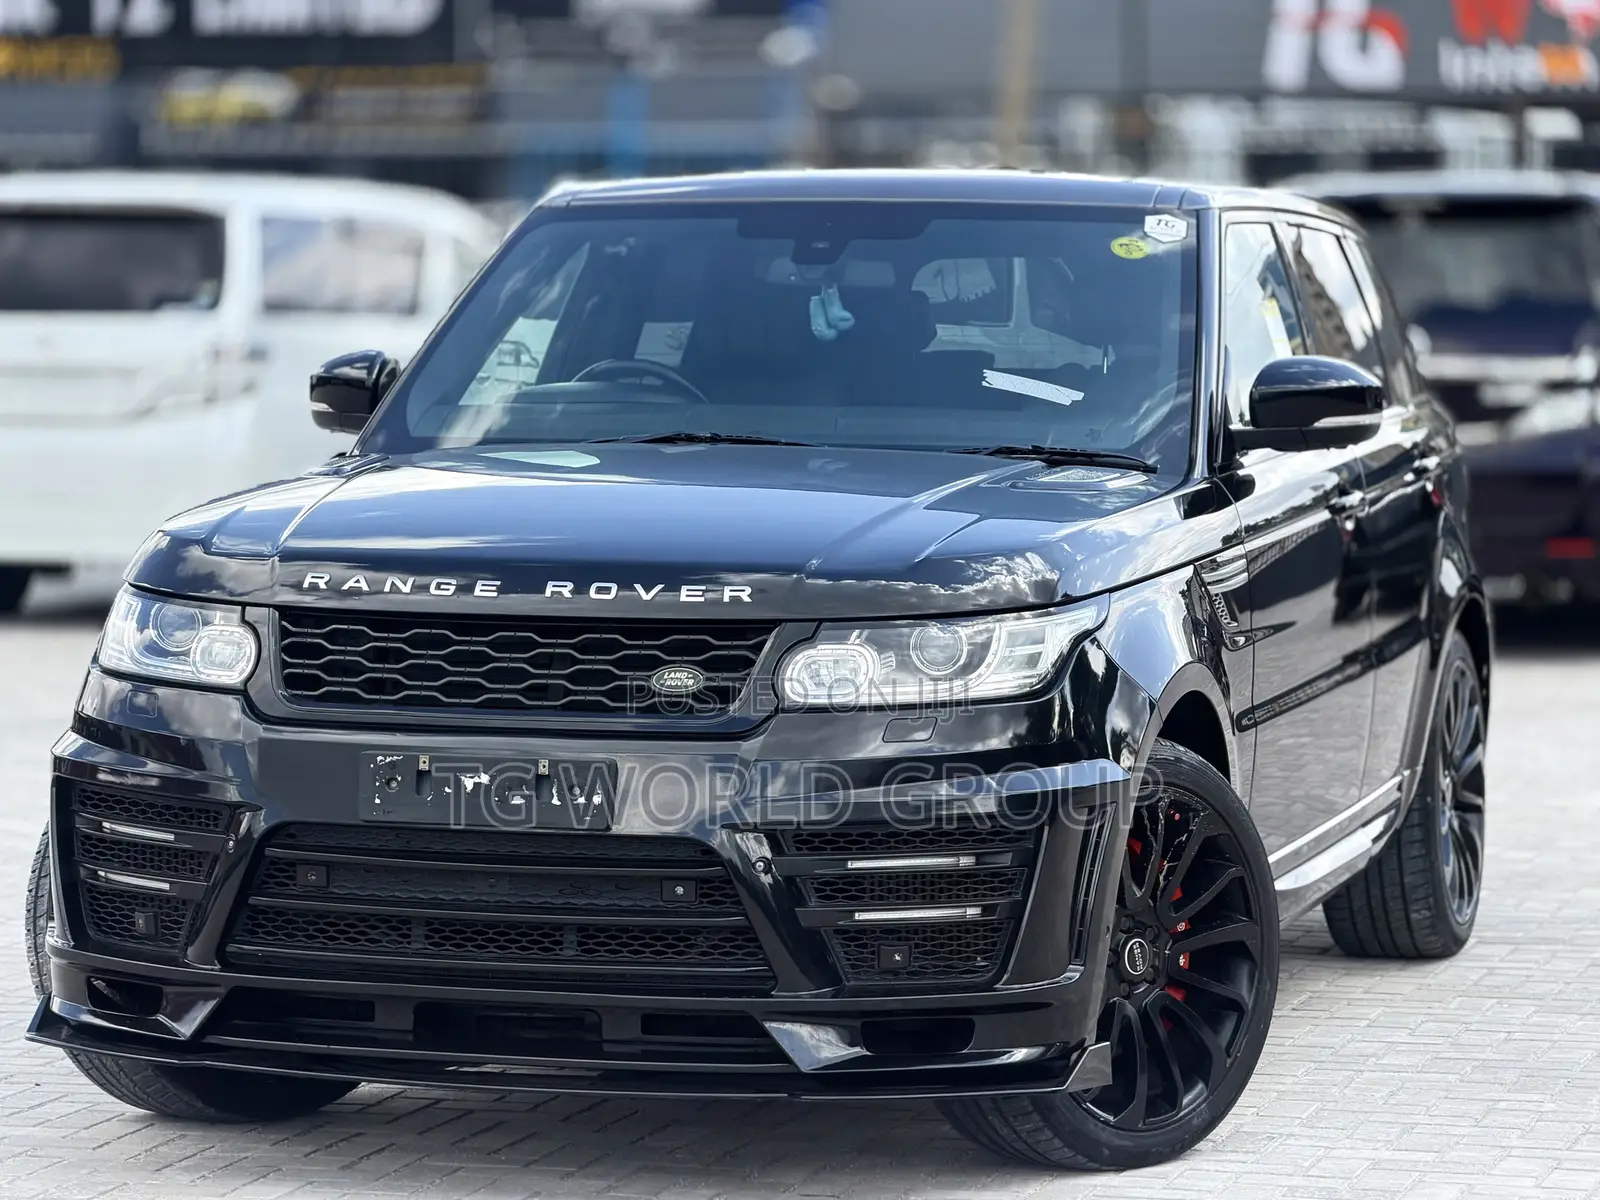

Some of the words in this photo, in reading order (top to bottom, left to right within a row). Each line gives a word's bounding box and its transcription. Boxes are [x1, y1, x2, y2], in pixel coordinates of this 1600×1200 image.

[302, 571, 502, 597] RANGE
[544, 580, 753, 603] ROVER
[664, 678, 695, 686] ROVER
